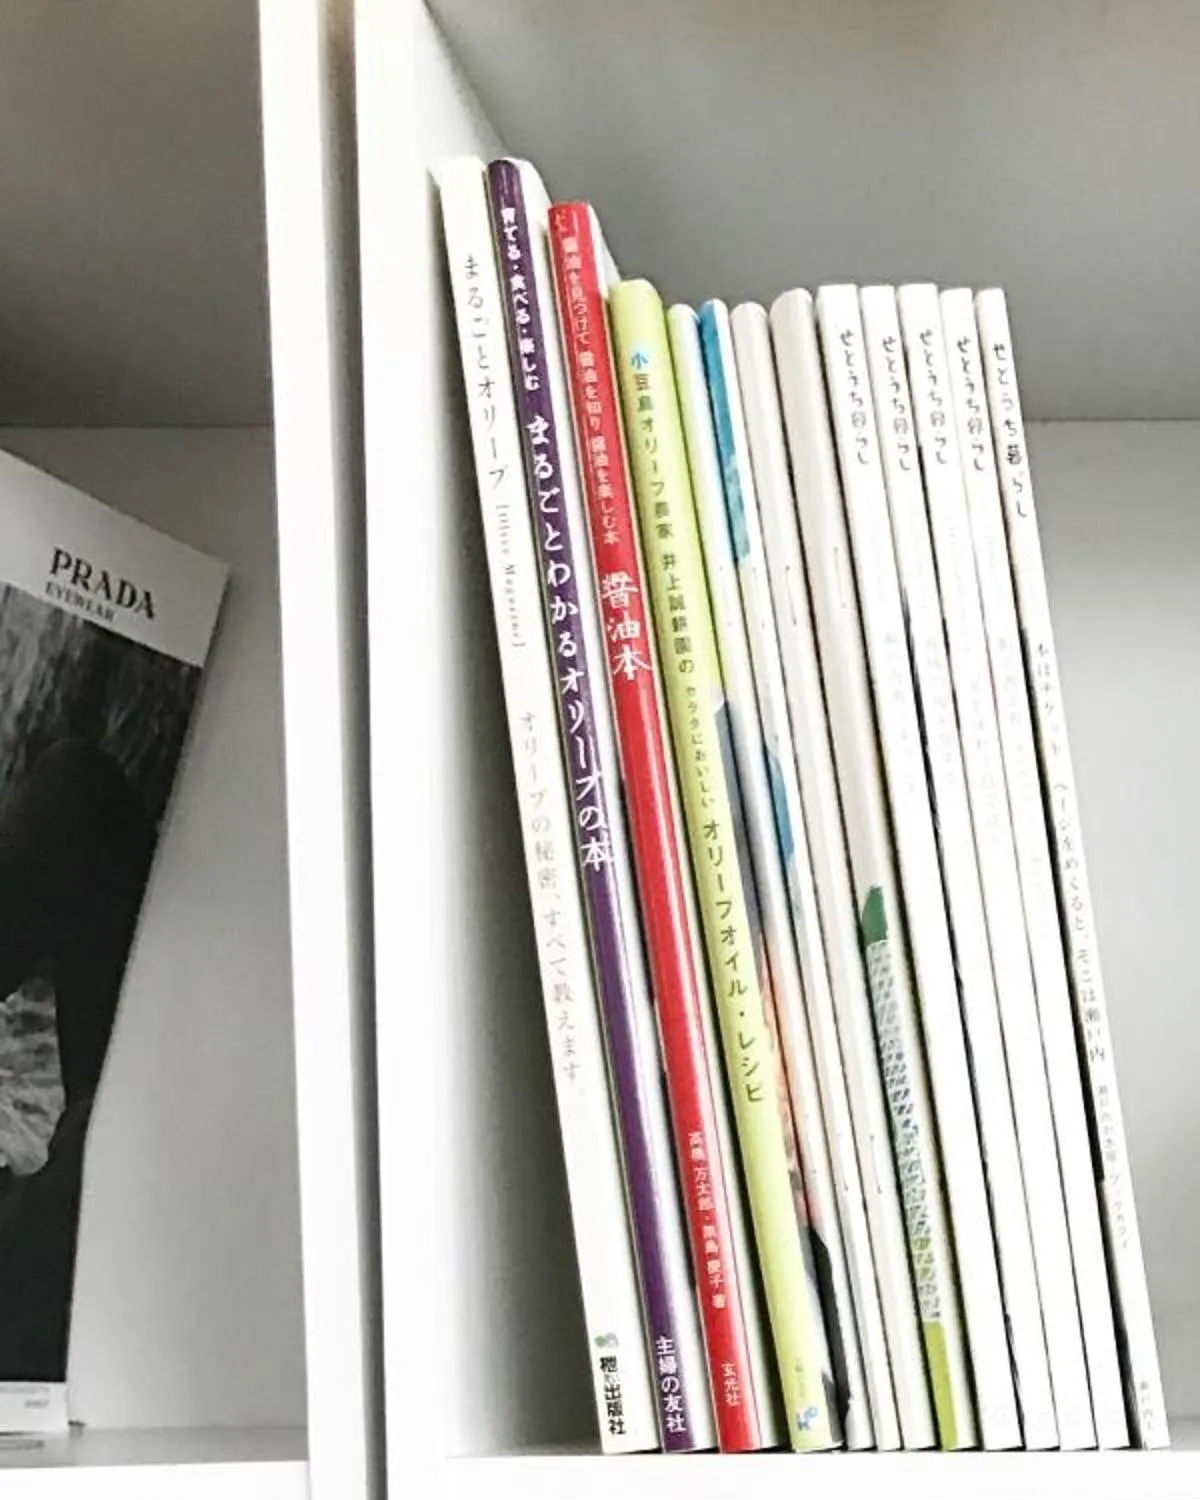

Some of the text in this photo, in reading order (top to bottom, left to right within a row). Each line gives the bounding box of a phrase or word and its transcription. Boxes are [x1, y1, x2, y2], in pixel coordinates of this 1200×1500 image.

[50, 546, 156, 620] PRADA
[525, 414, 615, 873] まるごとわかるオリーブの本
[655, 1335, 687, 1433] 主婦の友社
